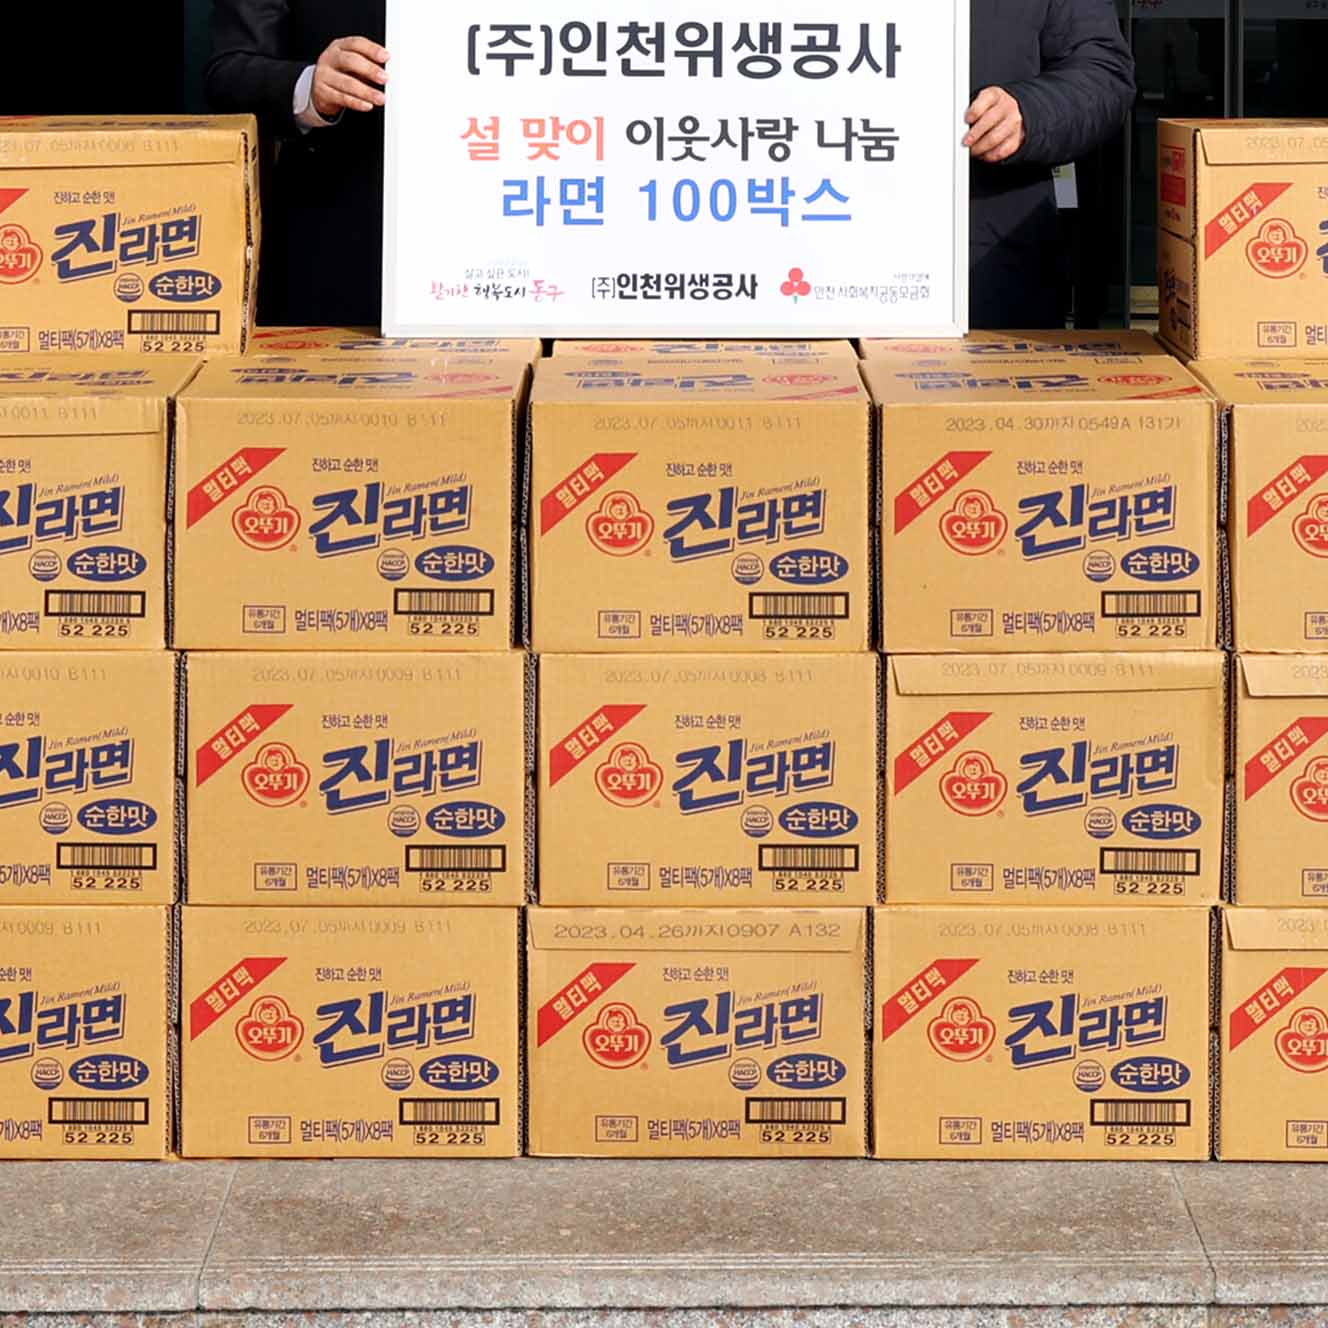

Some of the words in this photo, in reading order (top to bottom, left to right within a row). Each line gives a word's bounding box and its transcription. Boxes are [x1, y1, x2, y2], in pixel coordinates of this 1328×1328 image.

[460, 115, 501, 162] 설
[521, 115, 604, 162] 맞이
[625, 114, 799, 163] 이웃사랑
[815, 115, 900, 162] 나눔
[501, 175, 604, 227] 라면
[639, 175, 853, 227] 100박스
[52, 212, 201, 283] 진라면
[473, 281, 527, 302] 행복도시
[527, 279, 566, 303] 동구
[244, 515, 288, 534] 오뚜기
[663, 486, 826, 562] 진라면
[1129, 553, 1191, 574] 순한맛
[211, 713, 260, 760] 멀티팩
[673, 738, 835, 815] 진라면
[1129, 812, 1192, 831] 순한맛
[205, 967, 254, 1013] 멀티팩
[897, 968, 946, 1015] 멀티팩
[660, 990, 823, 1070] 진라면
